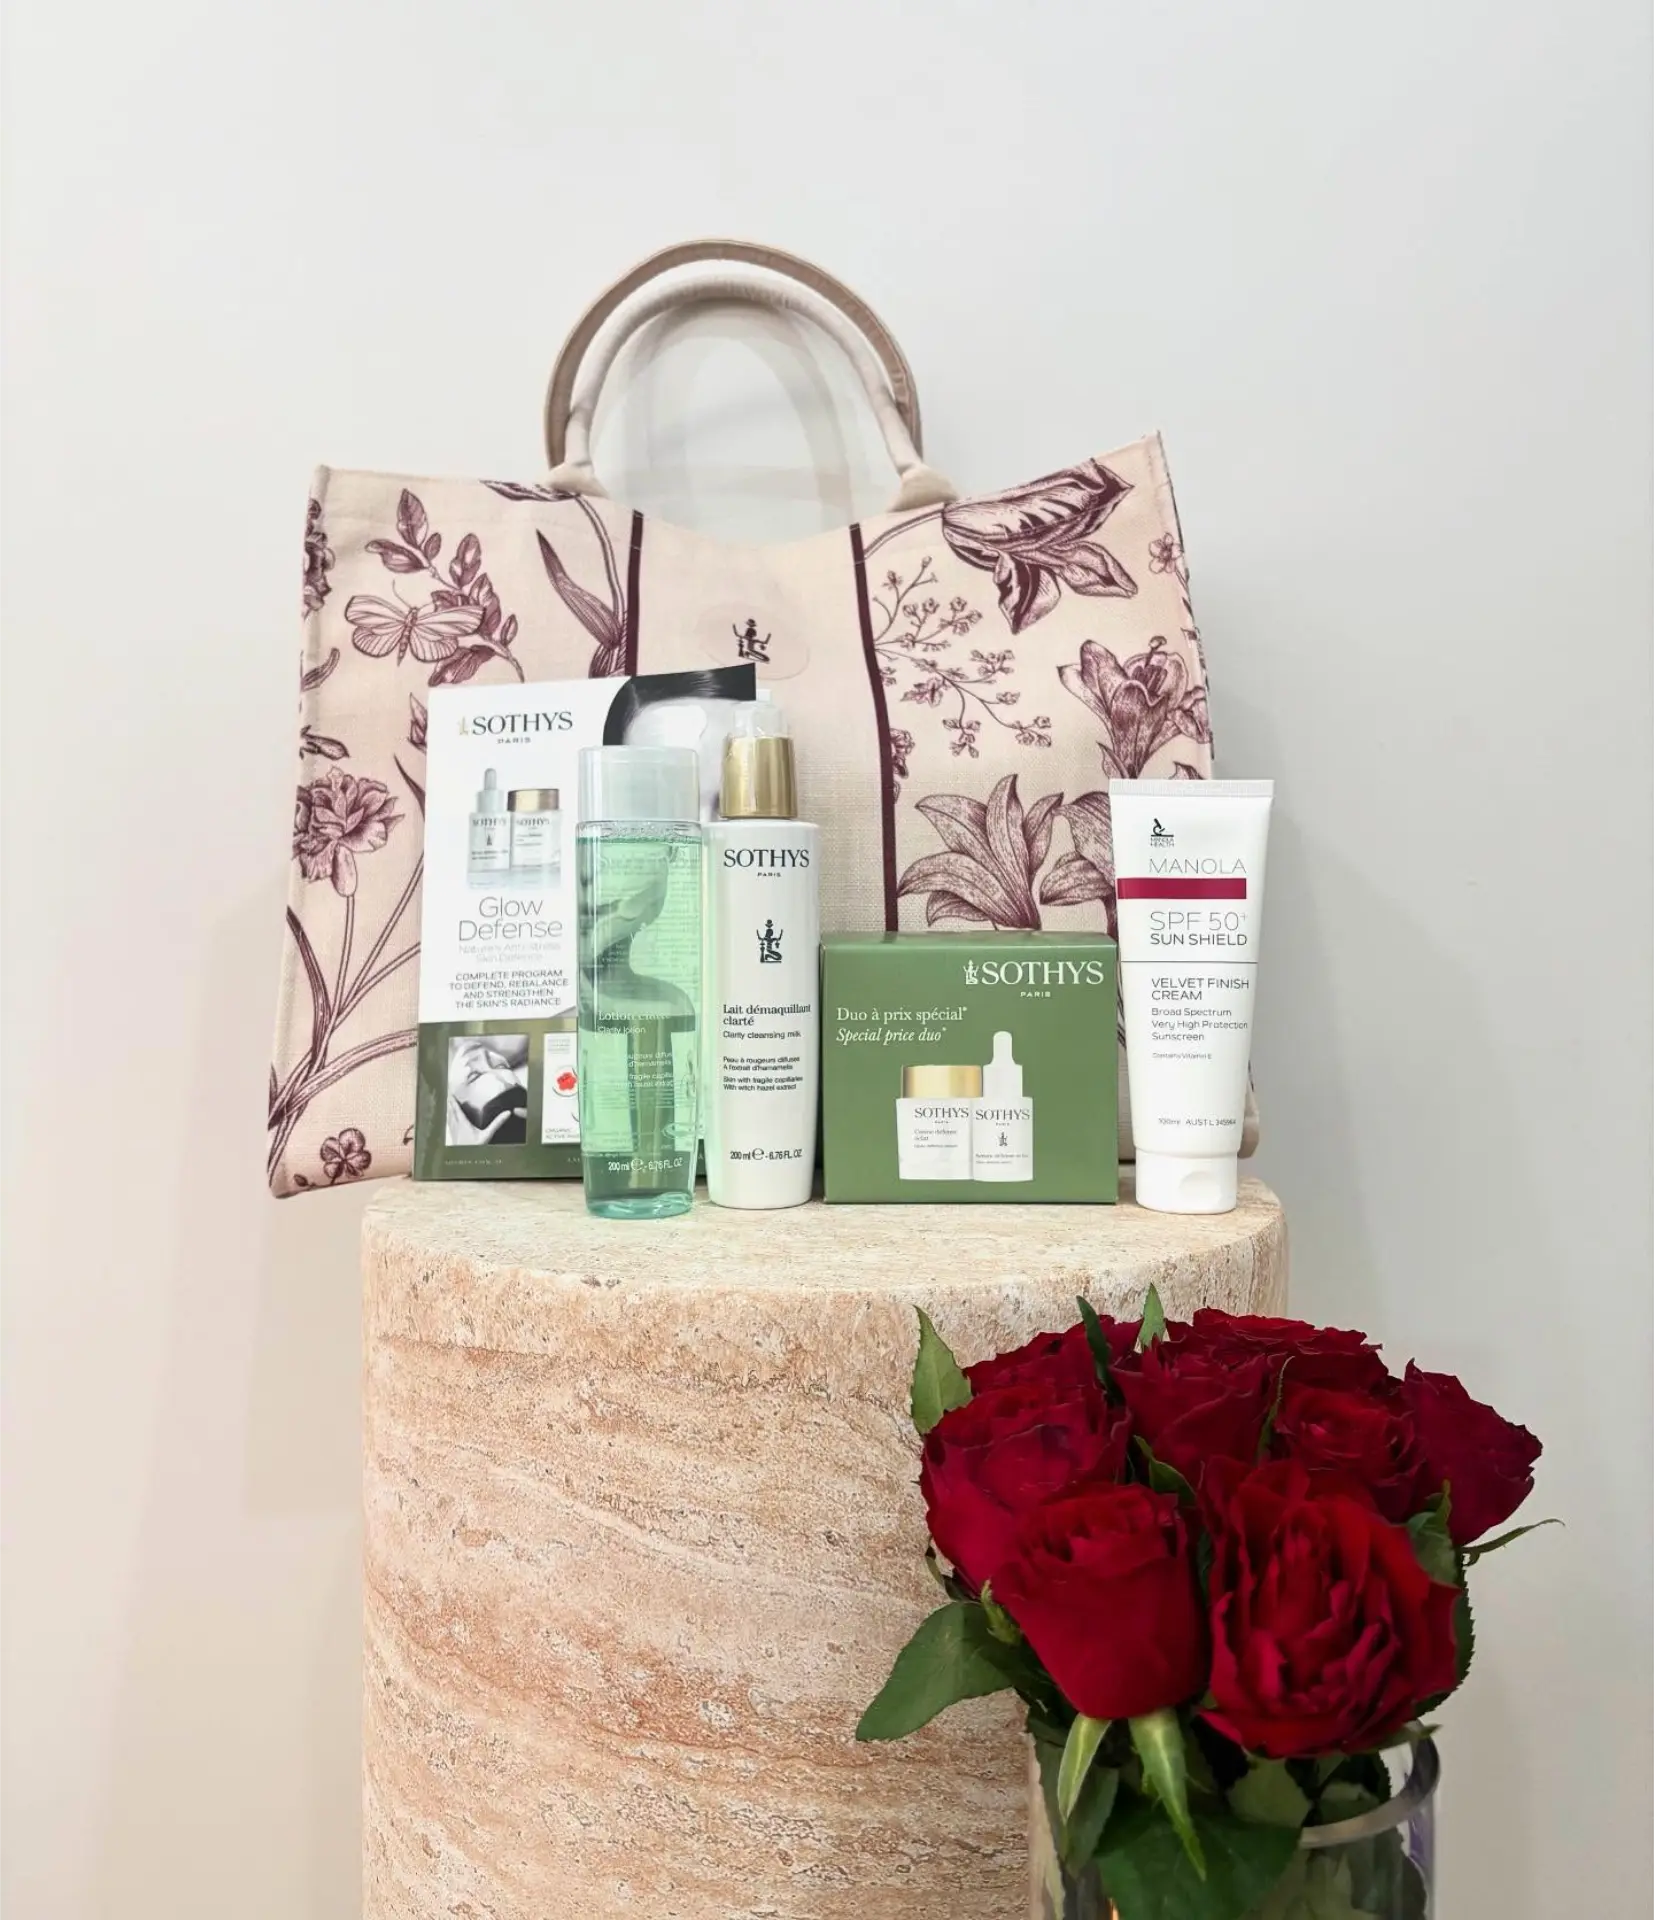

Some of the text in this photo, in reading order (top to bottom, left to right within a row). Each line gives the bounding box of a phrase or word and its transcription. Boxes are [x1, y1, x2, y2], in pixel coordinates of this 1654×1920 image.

[472, 711, 573, 736] SOTHYS
[723, 849, 810, 868] SOTHYS
[1149, 858, 1247, 874] MANOLA
[479, 896, 544, 918] Glow
[1150, 911, 1202, 931] SPF
[459, 918, 563, 941] Defense
[1150, 934, 1247, 946] SUN SHIELD
[456, 969, 563, 981] COMPLETE PROGRAM
[982, 961, 1104, 985] SOTHYS
[450, 978, 569, 990] TO DEFEND, REBALANCE
[1151, 978, 1249, 990] VELVET FINISH
[463, 988, 554, 999] AND STRENGTHEN
[1151, 990, 1203, 1000] CREAM
[456, 997, 561, 1009] THE SKIN'S RADIANCE
[723, 1004, 811, 1016] Lait démaquillant
[836, 1008, 867, 1021] Duo
[872, 1007, 880, 1021] à
[883, 1007, 912, 1024] prix
[1151, 1007, 1232, 1018] Broad Spectrum
[723, 1016, 754, 1026] clarté
[1151, 1020, 1248, 1030] Very High Protection
[723, 1030, 745, 1040] Clarity
[747, 1031, 785, 1040] cleansing
[836, 1027, 881, 1045] Special
[883, 1028, 914, 1045] price
[1151, 1032, 1204, 1041] Sunscreen
[914, 1107, 969, 1118] SOTHYS
[975, 1109, 1030, 1121] SOTHYS
[730, 1151, 742, 1160] 200
[742, 1150, 751, 1160] ml
[769, 1151, 783, 1160] 6.76
[608, 1162, 620, 1171] 200
[621, 1162, 630, 1171] ml
